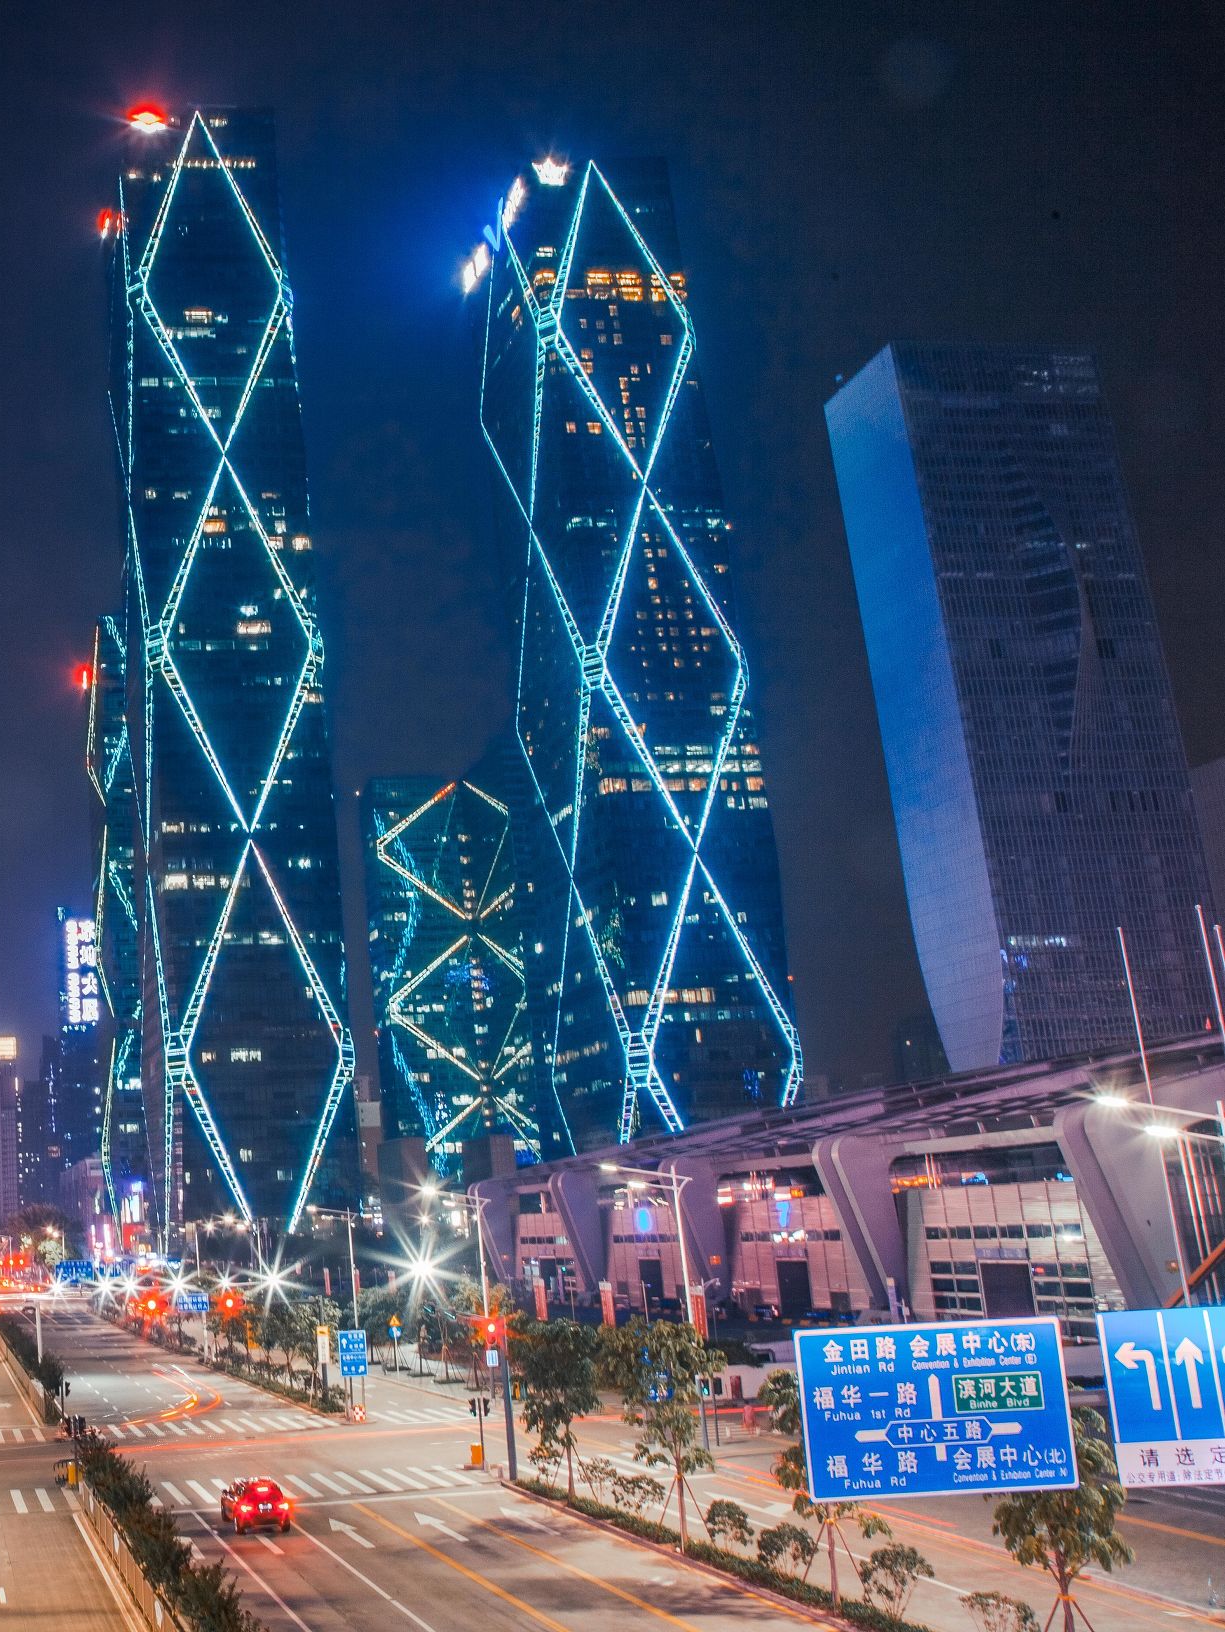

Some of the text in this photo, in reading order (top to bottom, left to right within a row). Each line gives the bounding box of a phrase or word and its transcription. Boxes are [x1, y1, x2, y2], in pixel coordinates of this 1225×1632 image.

[823, 1331, 1036, 1362] 金田路 会展中心(东)
[831, 1361, 895, 1376] Jintian Rd
[813, 1382, 918, 1410] 福华一路
[958, 1376, 1039, 1399] 滨河大道
[824, 1407, 911, 1422] Fuhua 1st Rd
[969, 1397, 1030, 1410] Binhe Blvd
[897, 1420, 982, 1444] 中心五路
[826, 1450, 918, 1479] 福华路
[953, 1444, 1067, 1471] 会展中心(北)
[1140, 1446, 1225, 1467] 请选定
[844, 1475, 907, 1490] Fuhua Rd
